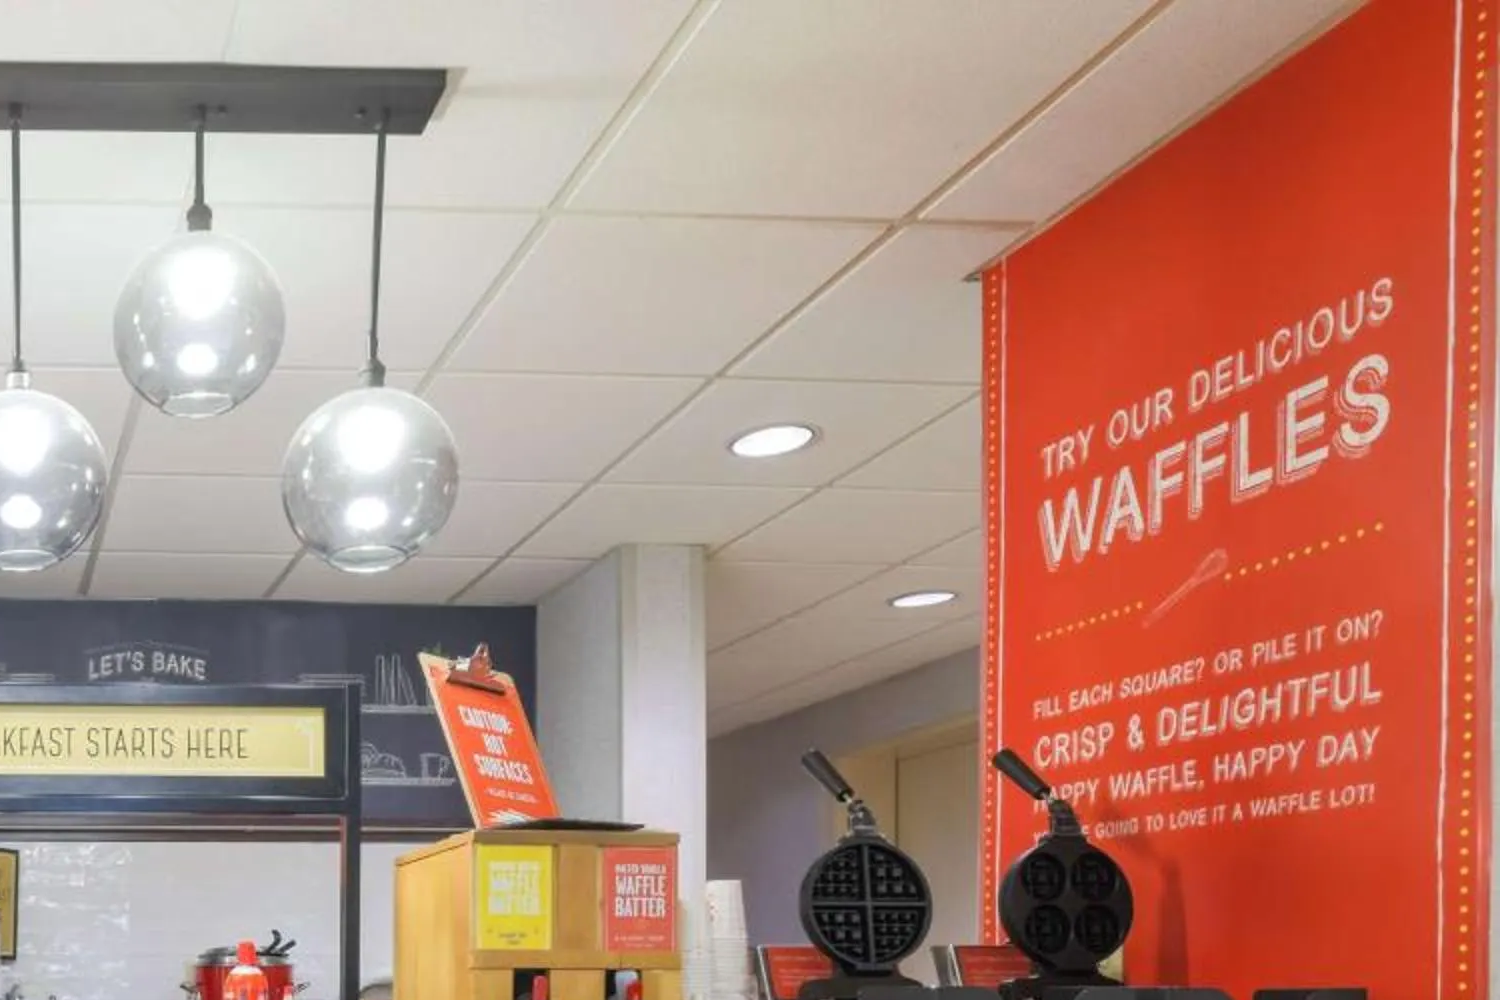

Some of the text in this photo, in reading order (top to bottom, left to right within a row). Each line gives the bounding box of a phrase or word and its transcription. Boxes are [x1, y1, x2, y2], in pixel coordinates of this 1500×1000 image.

[1041, 277, 1394, 481] TRY OUR DELICIOUS
[1037, 353, 1392, 572] WAFFLES
[87, 650, 208, 681] LET'S BAKE
[1032, 609, 1384, 721] FILL EACH SQUARE? OR PILE IT ON?
[85, 726, 176, 760] STARTS
[186, 727, 250, 761] HERE
[1032, 660, 1384, 769] CRISP & DELIGHTFUL
[1108, 758, 1206, 802] WAFFLE,
[1213, 738, 1305, 785] HAPPY
[1317, 726, 1381, 769] DAY
[1094, 816, 1140, 840] GOING
[1145, 810, 1165, 833] TO
[1168, 804, 1208, 830] LOVE
[1211, 802, 1227, 825] IT
[1232, 802, 1244, 822] A
[1250, 790, 1322, 819] WAFFLE
[1328, 782, 1377, 811] LOT!
[614, 875, 667, 897] WAFFLE
[614, 896, 667, 919] BATTER
